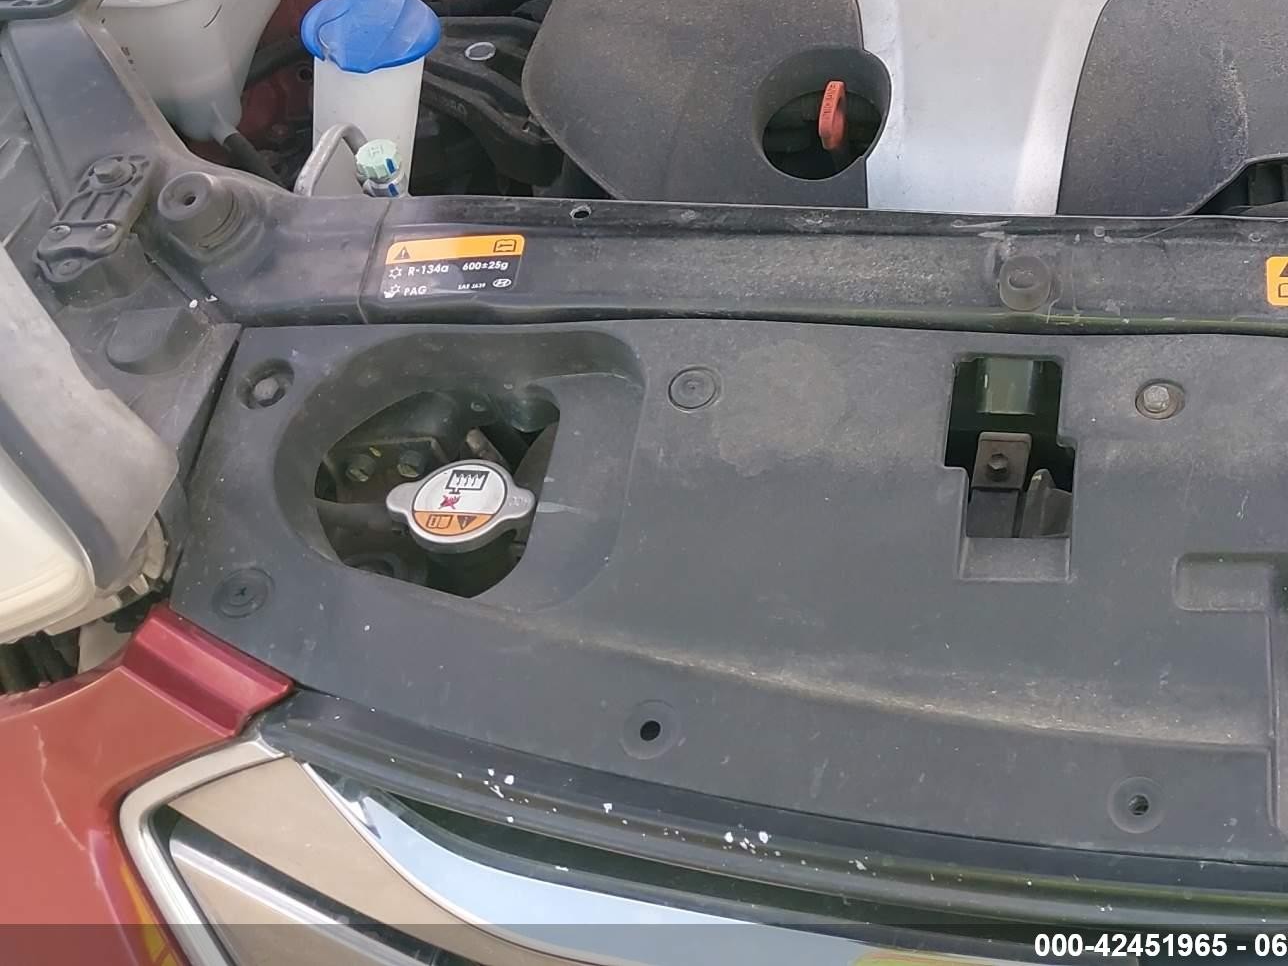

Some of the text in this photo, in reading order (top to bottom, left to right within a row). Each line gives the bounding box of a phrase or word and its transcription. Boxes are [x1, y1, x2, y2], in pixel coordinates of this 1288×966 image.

[407, 261, 509, 277] R-134a 600±25g
[403, 286, 427, 297] PAG
